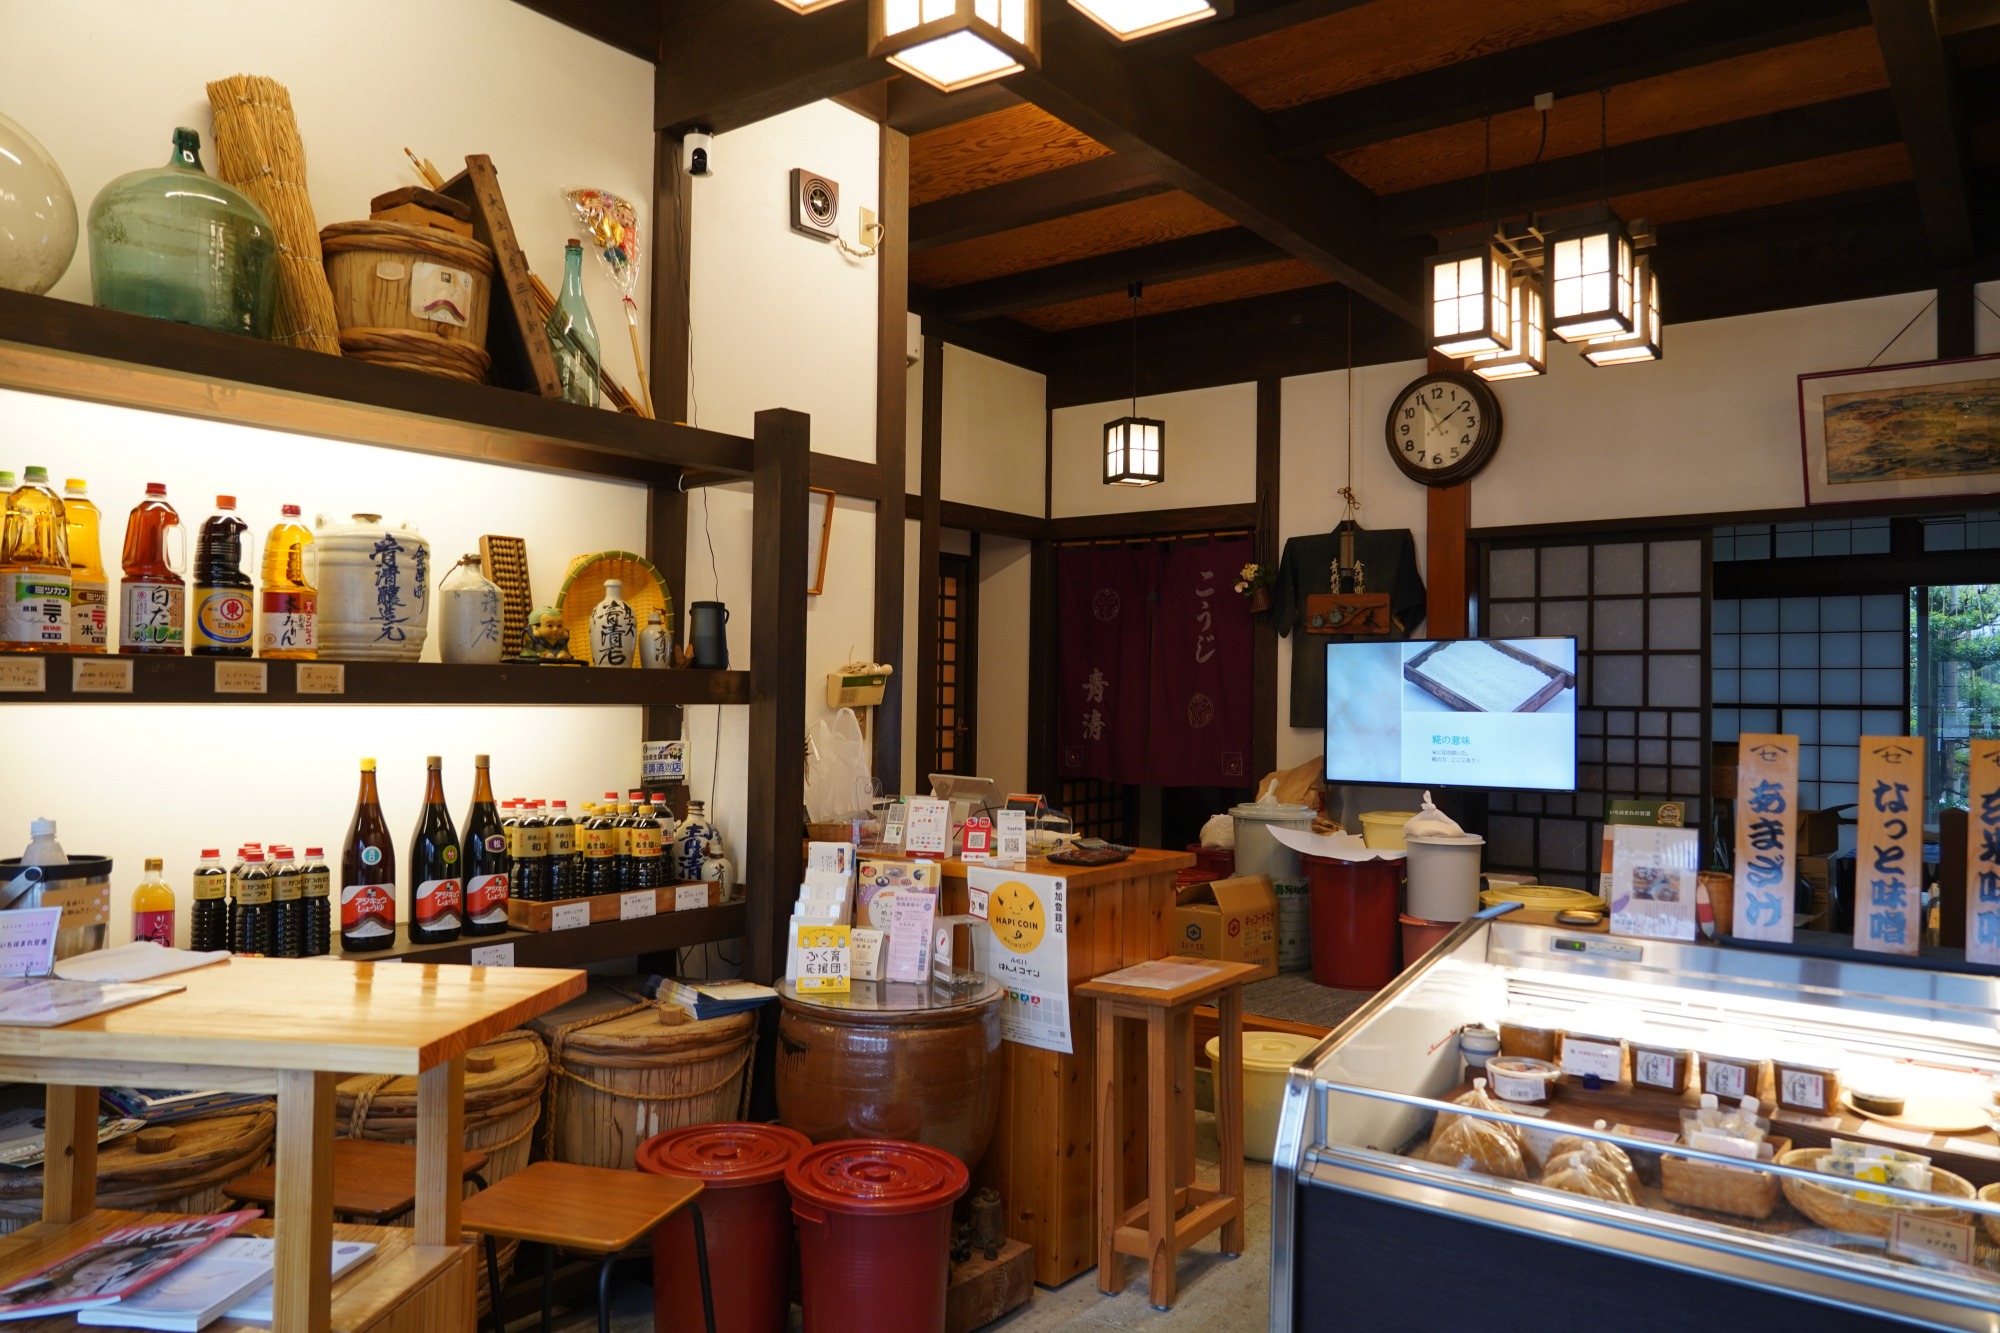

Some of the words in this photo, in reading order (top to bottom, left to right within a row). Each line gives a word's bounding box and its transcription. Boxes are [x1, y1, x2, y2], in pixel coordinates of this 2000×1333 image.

[1431, 387, 1443, 400] 12
[1450, 390, 1455, 401] 1
[1415, 394, 1425, 406] 11
[1461, 400, 1471, 412] 2
[1404, 407, 1415, 419] 10
[1466, 416, 1476, 428] 3
[1400, 424, 1410, 435] 9
[1460, 434, 1471, 445] 4
[1405, 440, 1415, 452] 8
[1417, 450, 1425, 462] 7
[1450, 447, 1459, 458] 5
[1432, 453, 1442, 465] 6
[35, 585, 68, 596] ミツカン
[86, 592, 108, 601] ミツカ
[150, 585, 172, 643] 白だし
[226, 601, 239, 619] 東
[281, 595, 302, 647] 本みりん
[1195, 570, 1217, 664] こうじ
[81, 625, 93, 635] 米
[218, 621, 245, 629] ヒガシマル
[134, 622, 148, 643] つゆ
[1081, 668, 1109, 741] 青清
[1431, 735, 1471, 745] 糀の意味
[1608, 809, 1651, 817] いちほまれの甘酒
[493, 839, 501, 848] 松
[678, 823, 711, 880] 青清
[1746, 779, 1787, 927] あまざけ
[1869, 779, 1910, 946] なっと味噌
[437, 898, 459, 907] しょうゆ
[487, 892, 507, 901] しょうゆ
[357, 904, 385, 913] しょうゆ
[1054, 881, 1063, 934] 参加登録店
[996, 916, 1015, 926] HAPI
[1017, 921, 1038, 930] COIN
[808, 949, 841, 962] ふく育
[1010, 957, 1027, 965] ふくい
[805, 963, 841, 974] 応援団
[102, 1214, 239, 1245] URALA
